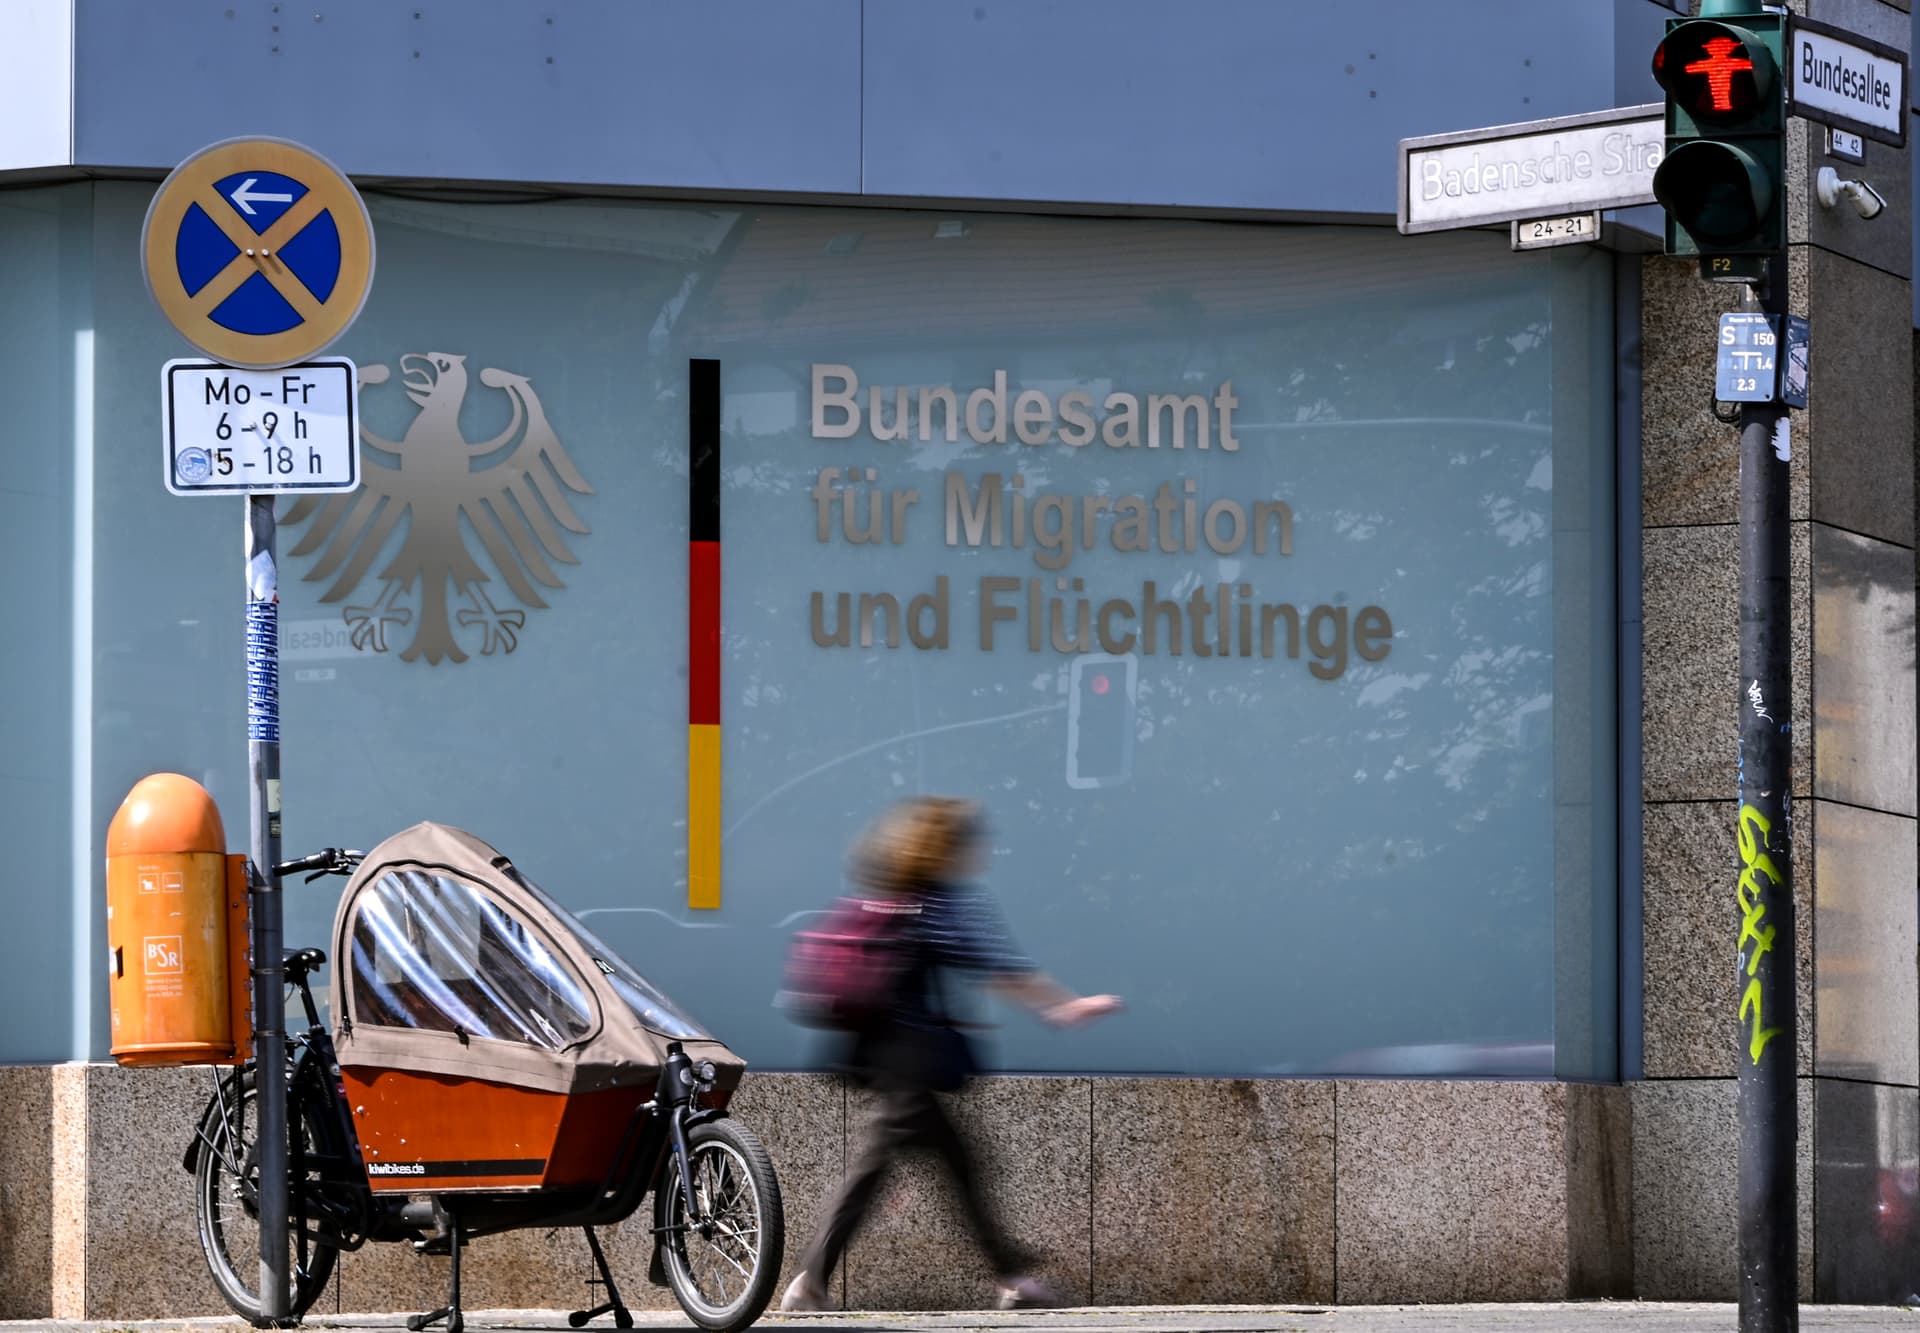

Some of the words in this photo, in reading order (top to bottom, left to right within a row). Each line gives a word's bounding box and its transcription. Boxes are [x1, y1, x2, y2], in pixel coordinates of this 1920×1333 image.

[1802, 41, 1891, 111] Bundesallee
[1421, 141, 1592, 201] Badensche
[1602, 132, 1665, 176] Stra
[1712, 258, 1731, 271] F2
[1721, 326, 1736, 345] S
[1753, 332, 1775, 346] 150
[1756, 357, 1773, 370] 1.4
[1736, 378, 1756, 391] 2.3
[811, 363, 1240, 452] Bundesamt
[294, 411, 307, 439] h
[309, 446, 322, 474] h
[812, 467, 920, 544] für
[945, 471, 1294, 570] Migration
[811, 575, 949, 650] und
[980, 576, 1393, 681] Flüchtlinge
[147, 943, 179, 968] BSR
[368, 1162, 425, 1175] kiwibikes.de
